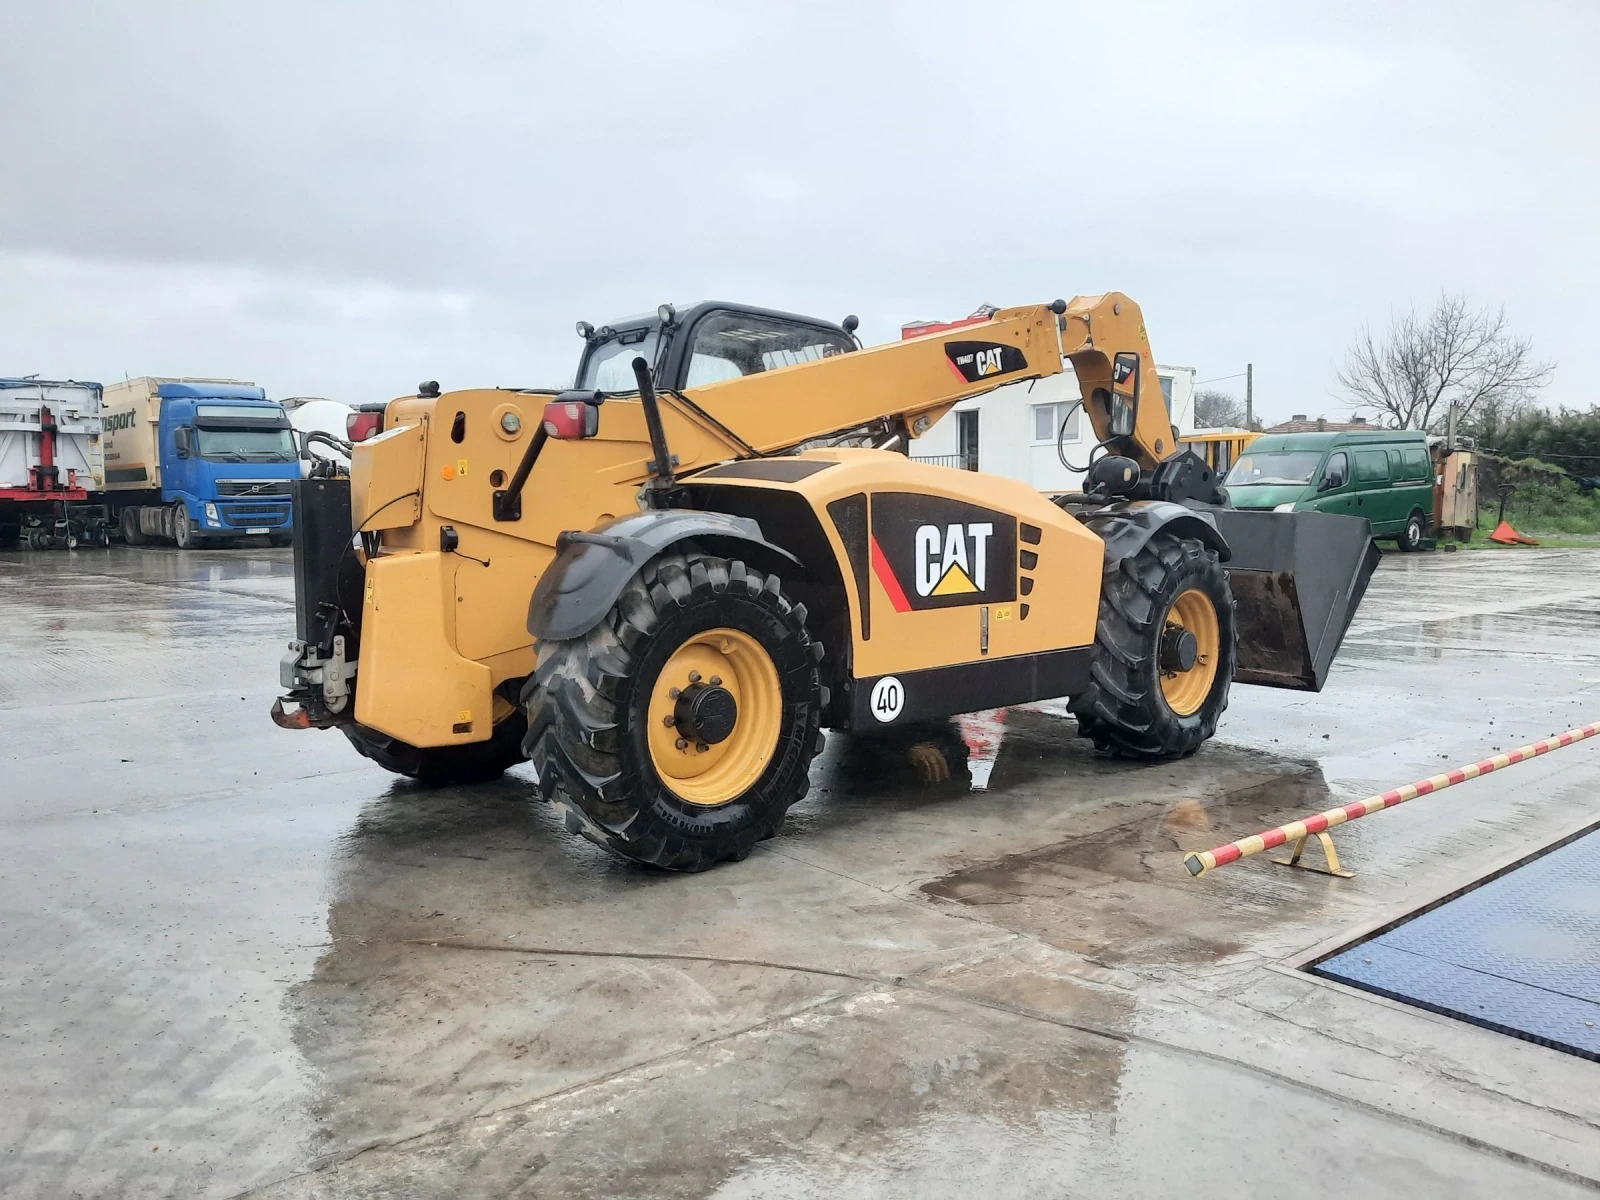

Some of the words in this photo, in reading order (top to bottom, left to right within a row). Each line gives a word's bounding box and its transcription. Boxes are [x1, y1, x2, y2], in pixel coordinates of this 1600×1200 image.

[976, 347, 1003, 376] CAT
[100, 408, 136, 436] nsport
[915, 522, 994, 597] CAT
[876, 685, 898, 713] 40
